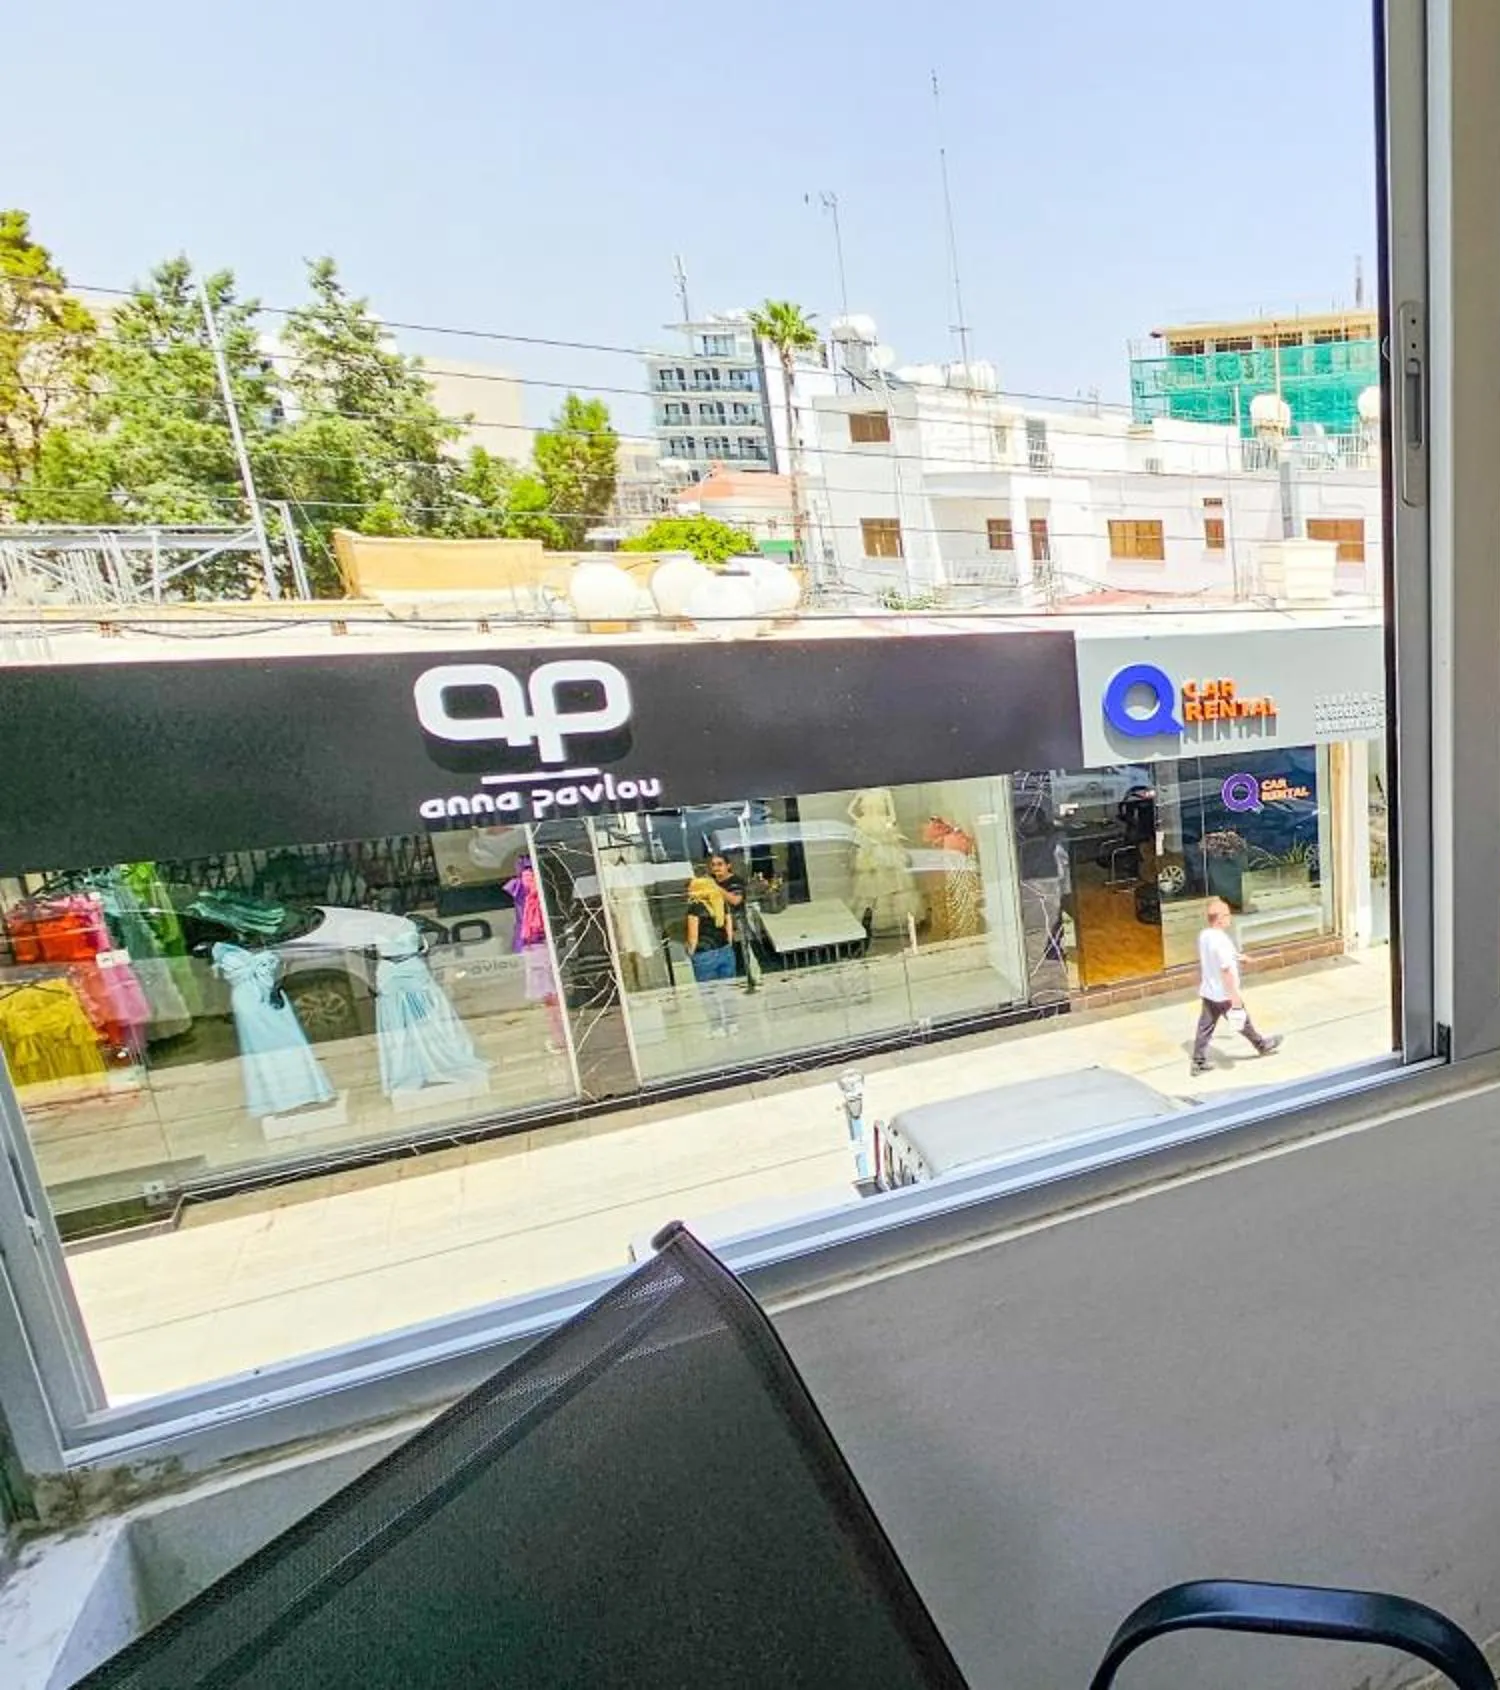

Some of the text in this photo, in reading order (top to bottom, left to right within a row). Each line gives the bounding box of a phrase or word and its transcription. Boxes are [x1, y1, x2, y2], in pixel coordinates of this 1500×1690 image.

[1182, 676, 1238, 701] CAR
[1183, 695, 1280, 722] RENTAL
[419, 773, 662, 819] anna pavlou
[1261, 777, 1289, 791] CAR
[1261, 786, 1312, 802] RENTAL
